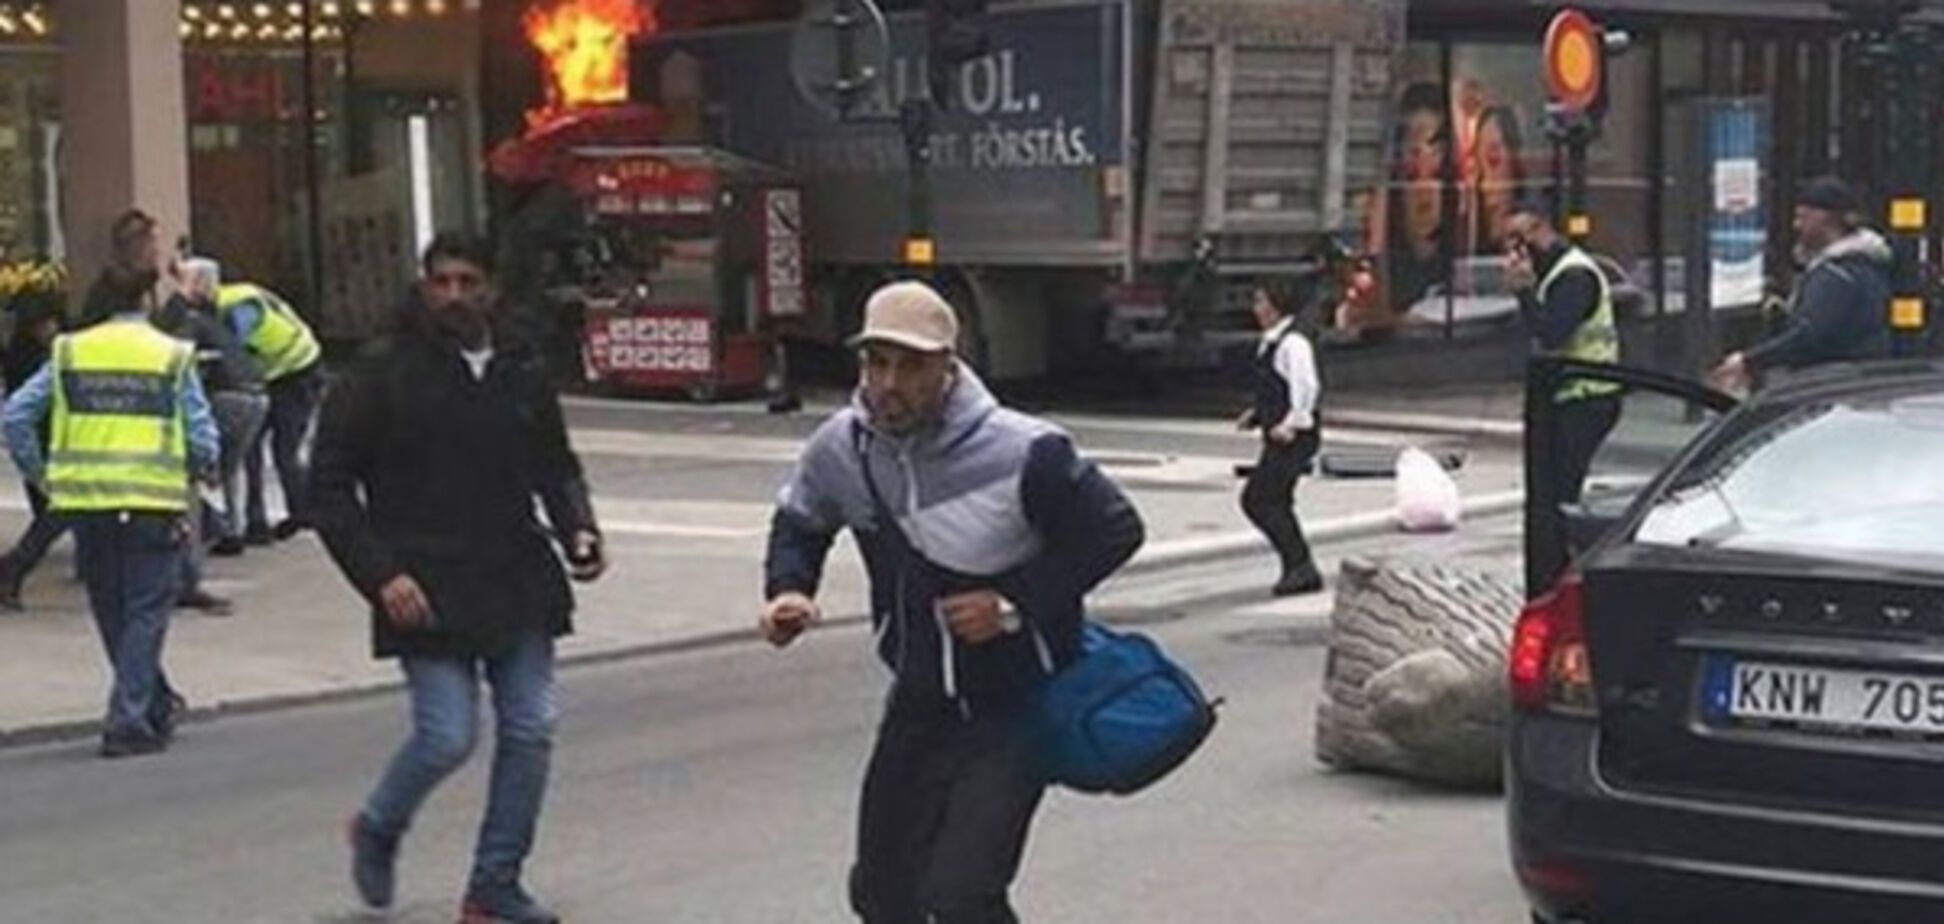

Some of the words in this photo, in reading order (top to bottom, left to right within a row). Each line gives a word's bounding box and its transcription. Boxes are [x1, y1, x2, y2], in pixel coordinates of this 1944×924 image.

[969, 118, 1096, 168] FÖRSTÅS.
[1738, 668, 1827, 716] KNW
[1862, 676, 1944, 727] 705
